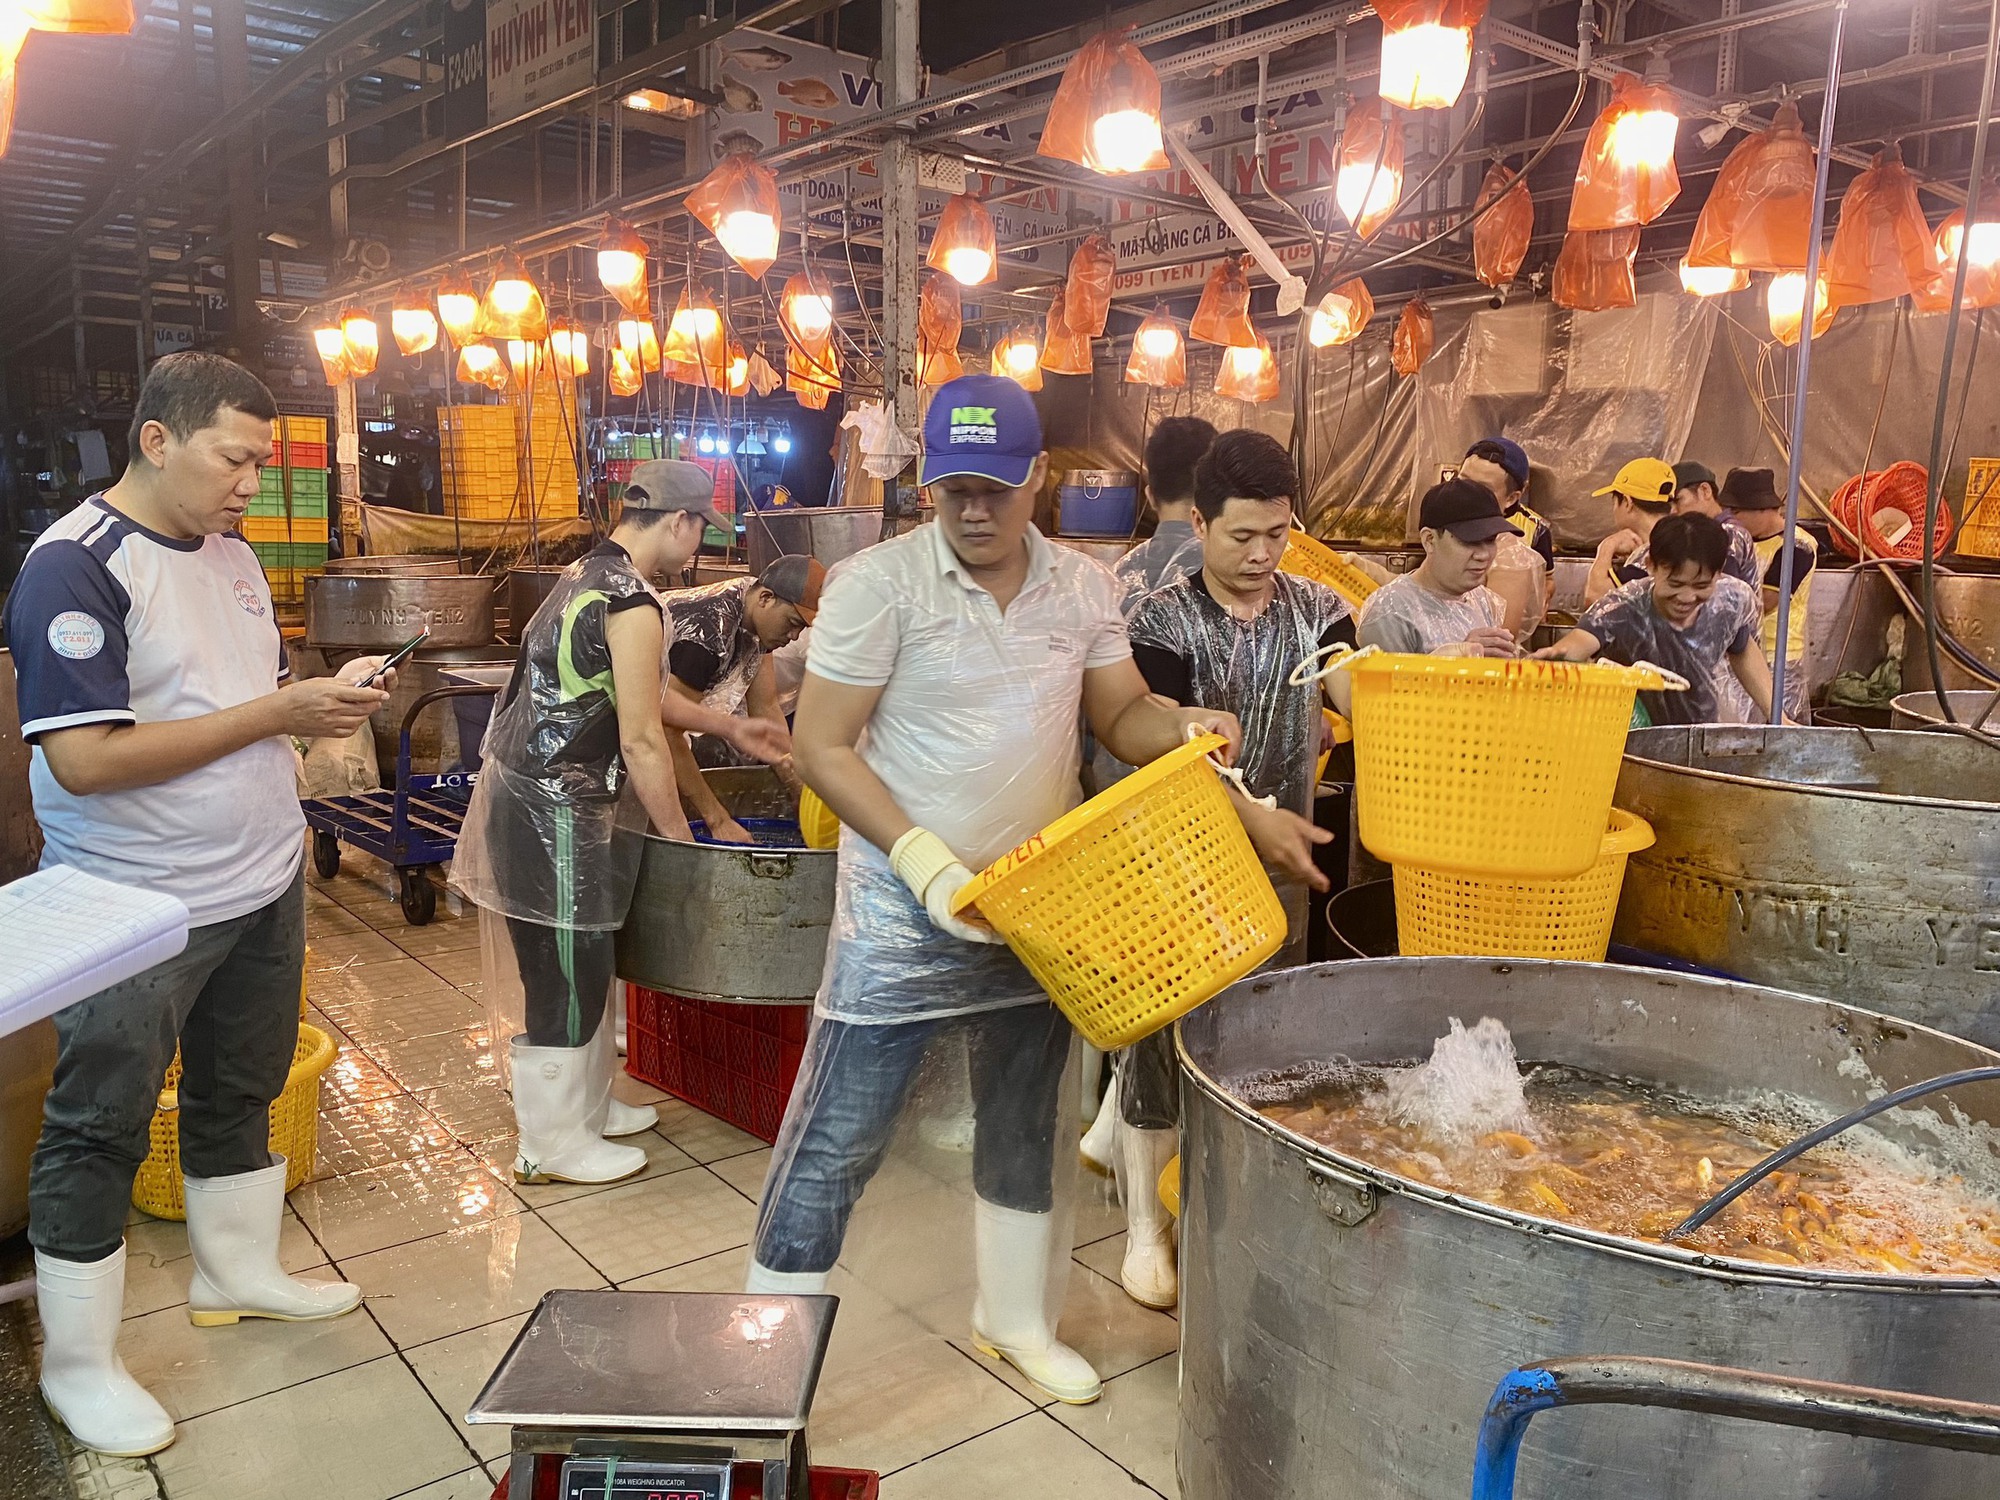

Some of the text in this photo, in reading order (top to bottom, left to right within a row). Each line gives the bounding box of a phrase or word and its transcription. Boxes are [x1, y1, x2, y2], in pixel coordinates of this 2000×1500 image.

[1192, 219, 1211, 245] CÁ
[208, 294, 229, 310] F2-
[627, 1478, 655, 1486] WEIGHING
[656, 1479, 686, 1487] INDICATOR
